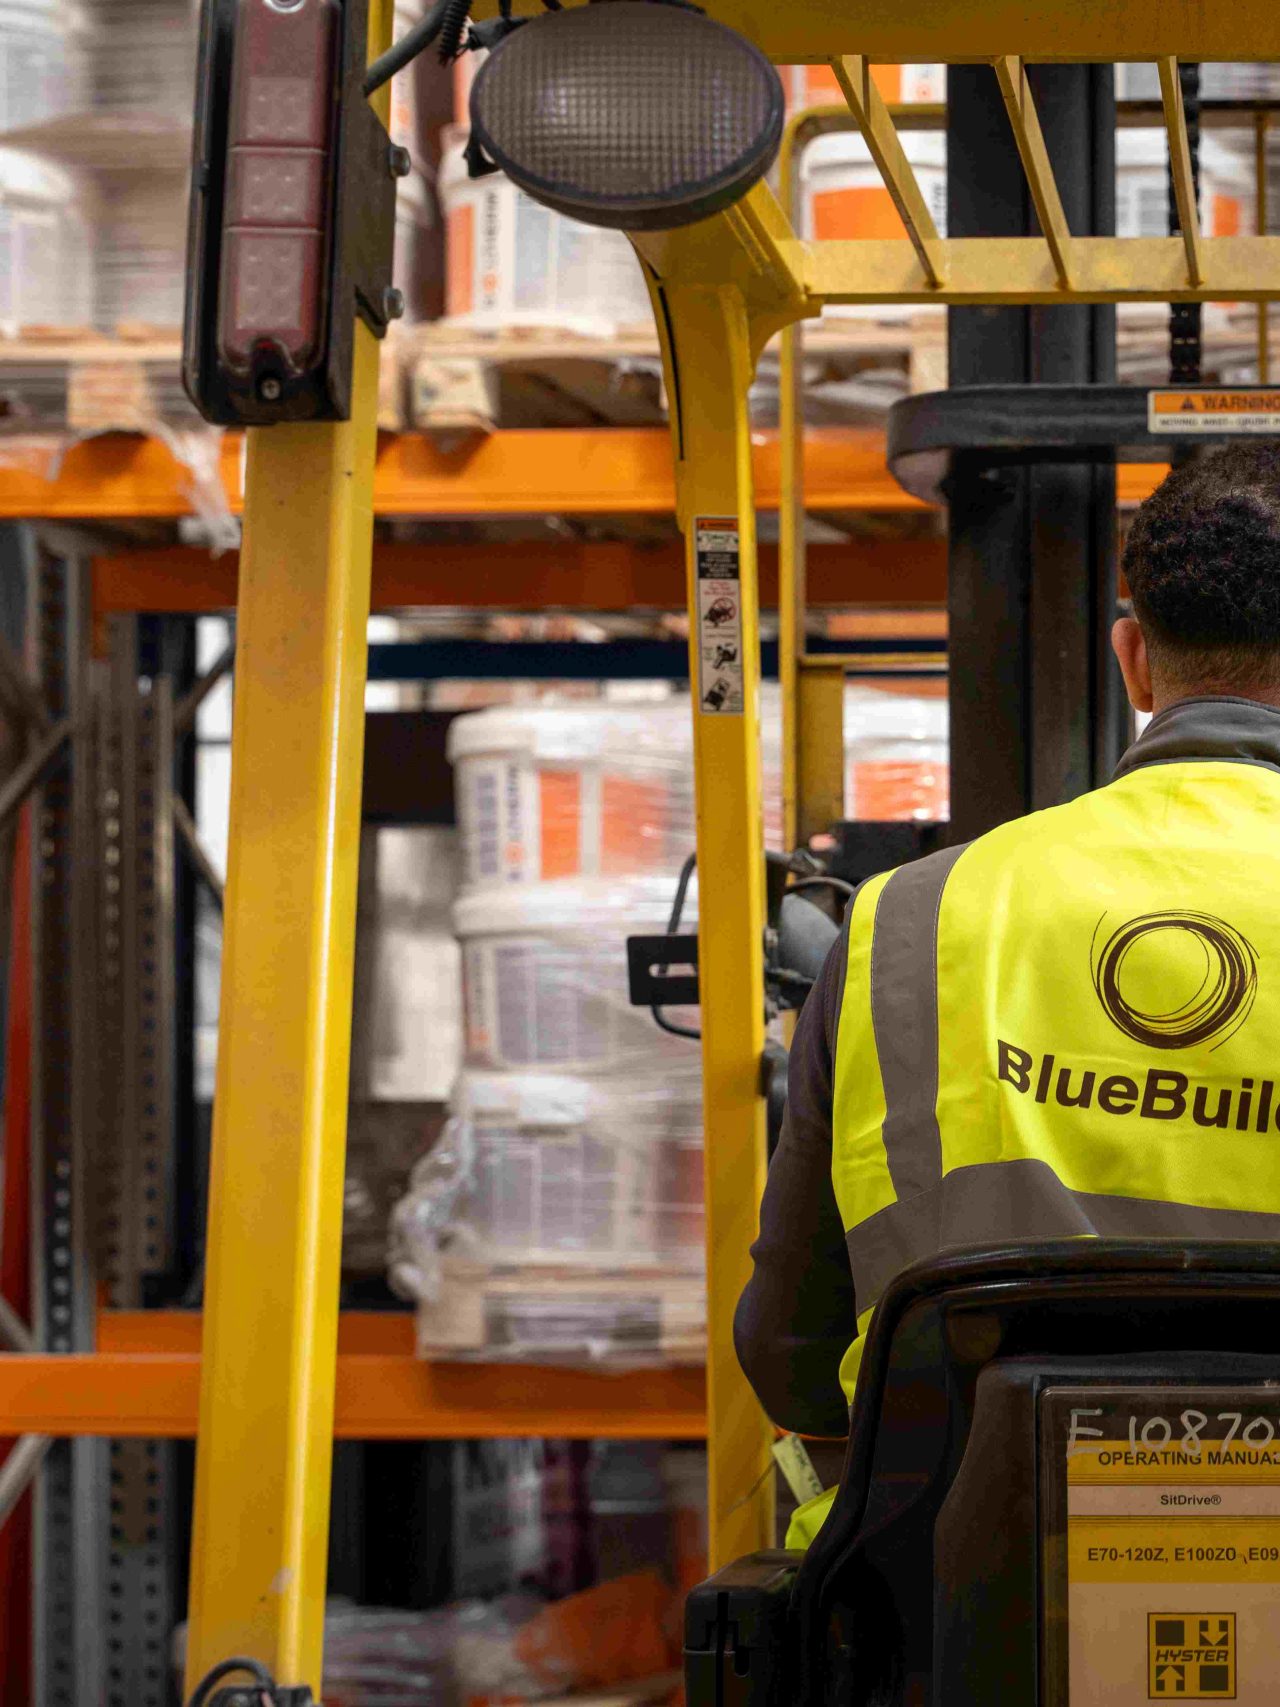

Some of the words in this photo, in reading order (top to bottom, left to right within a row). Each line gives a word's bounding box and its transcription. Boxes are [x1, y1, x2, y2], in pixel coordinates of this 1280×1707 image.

[1098, 1451, 1202, 1466] OPERATING
[1087, 1548, 1169, 1564] E70-120Z,
[1155, 1649, 1229, 1662] HYSTER
